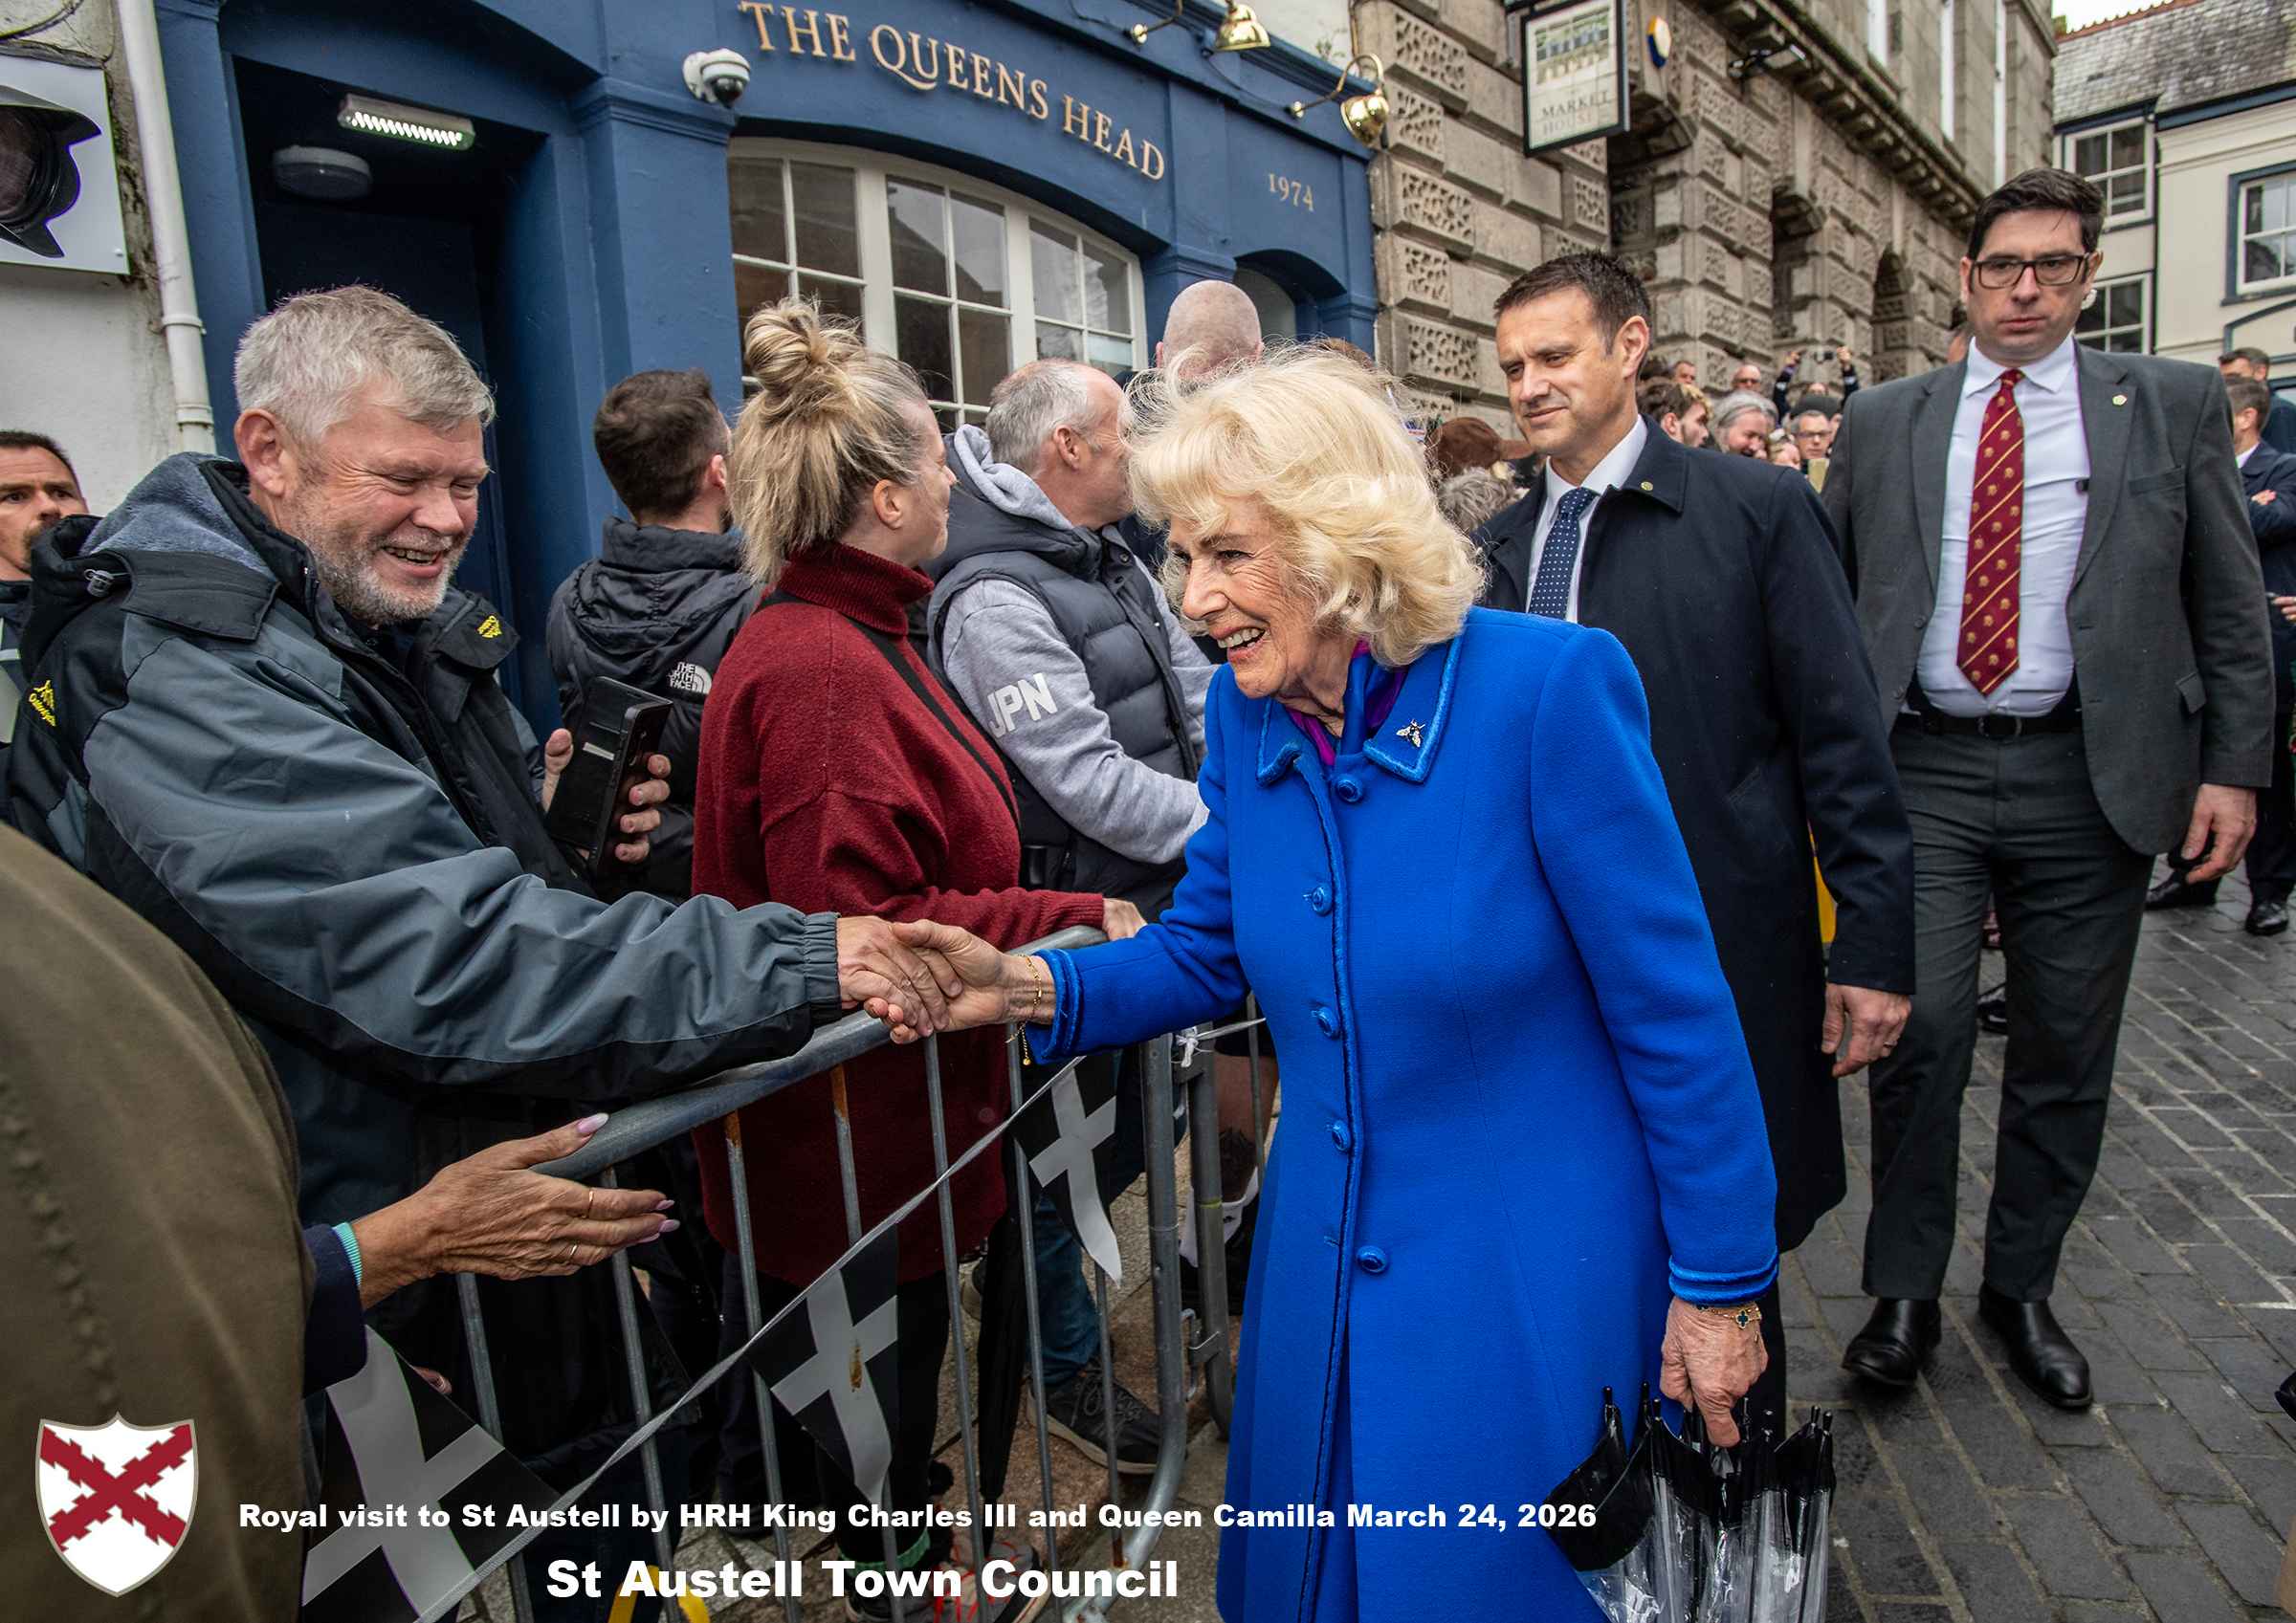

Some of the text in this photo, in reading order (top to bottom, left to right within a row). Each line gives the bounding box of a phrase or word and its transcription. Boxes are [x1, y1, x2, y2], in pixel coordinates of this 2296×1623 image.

[737, 0, 1165, 181] THE QUEENS HEAD
[1541, 90, 1608, 117] MARKET
[1269, 173, 1314, 212] 1974
[676, 661, 695, 673] THE
[986, 672, 1058, 738] JPN
